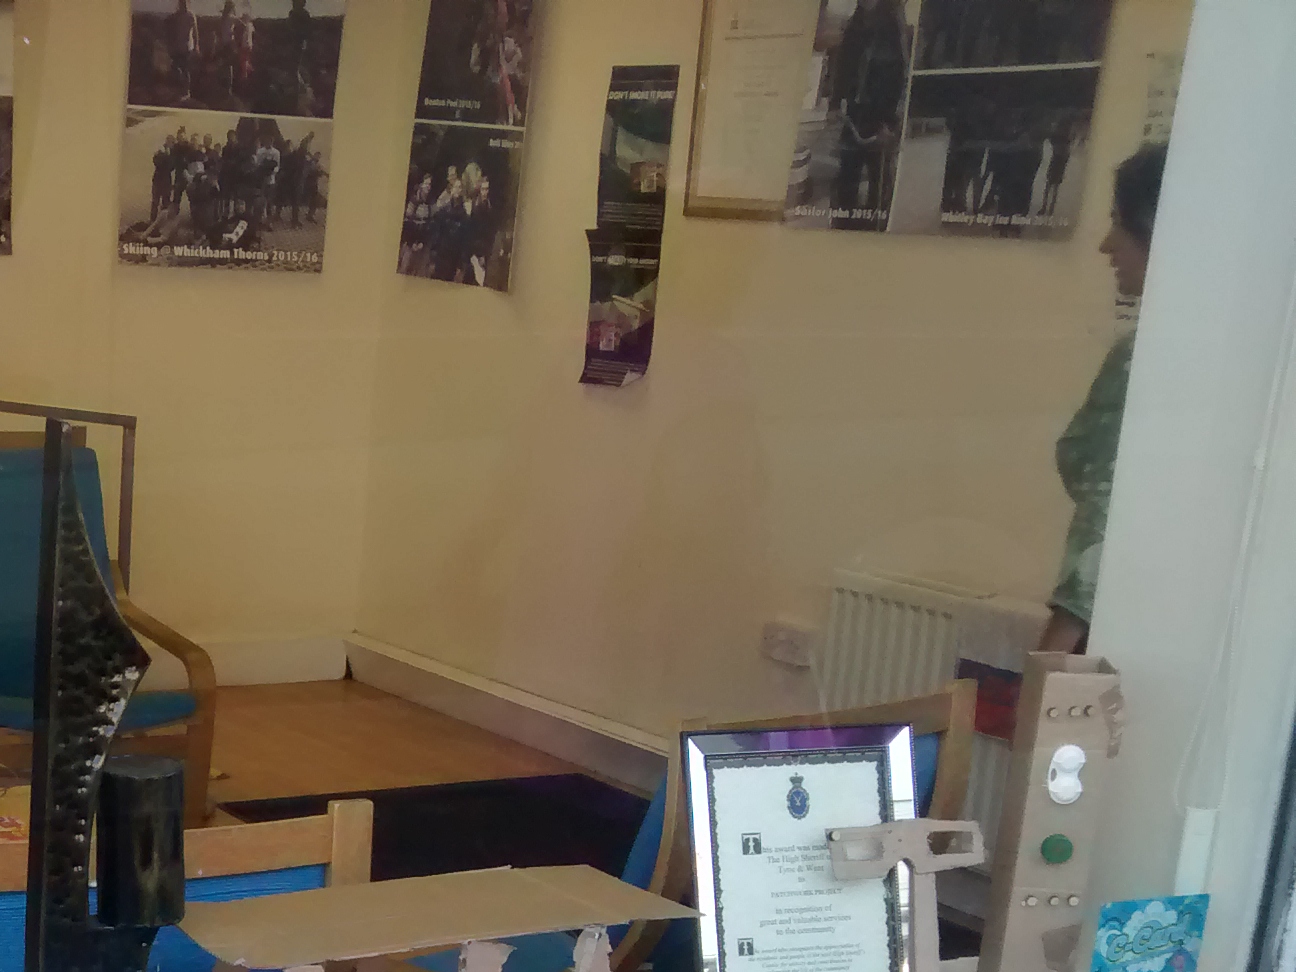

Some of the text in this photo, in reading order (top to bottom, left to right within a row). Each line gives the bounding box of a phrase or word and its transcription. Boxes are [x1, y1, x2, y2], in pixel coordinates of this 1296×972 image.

[122, 243, 158, 258] Skiing
[173, 245, 231, 260] Whickham
[233, 247, 269, 261] Thorns
[272, 249, 319, 266] 2015/16
[767, 855, 780, 864] The
[824, 903, 832, 912] of
